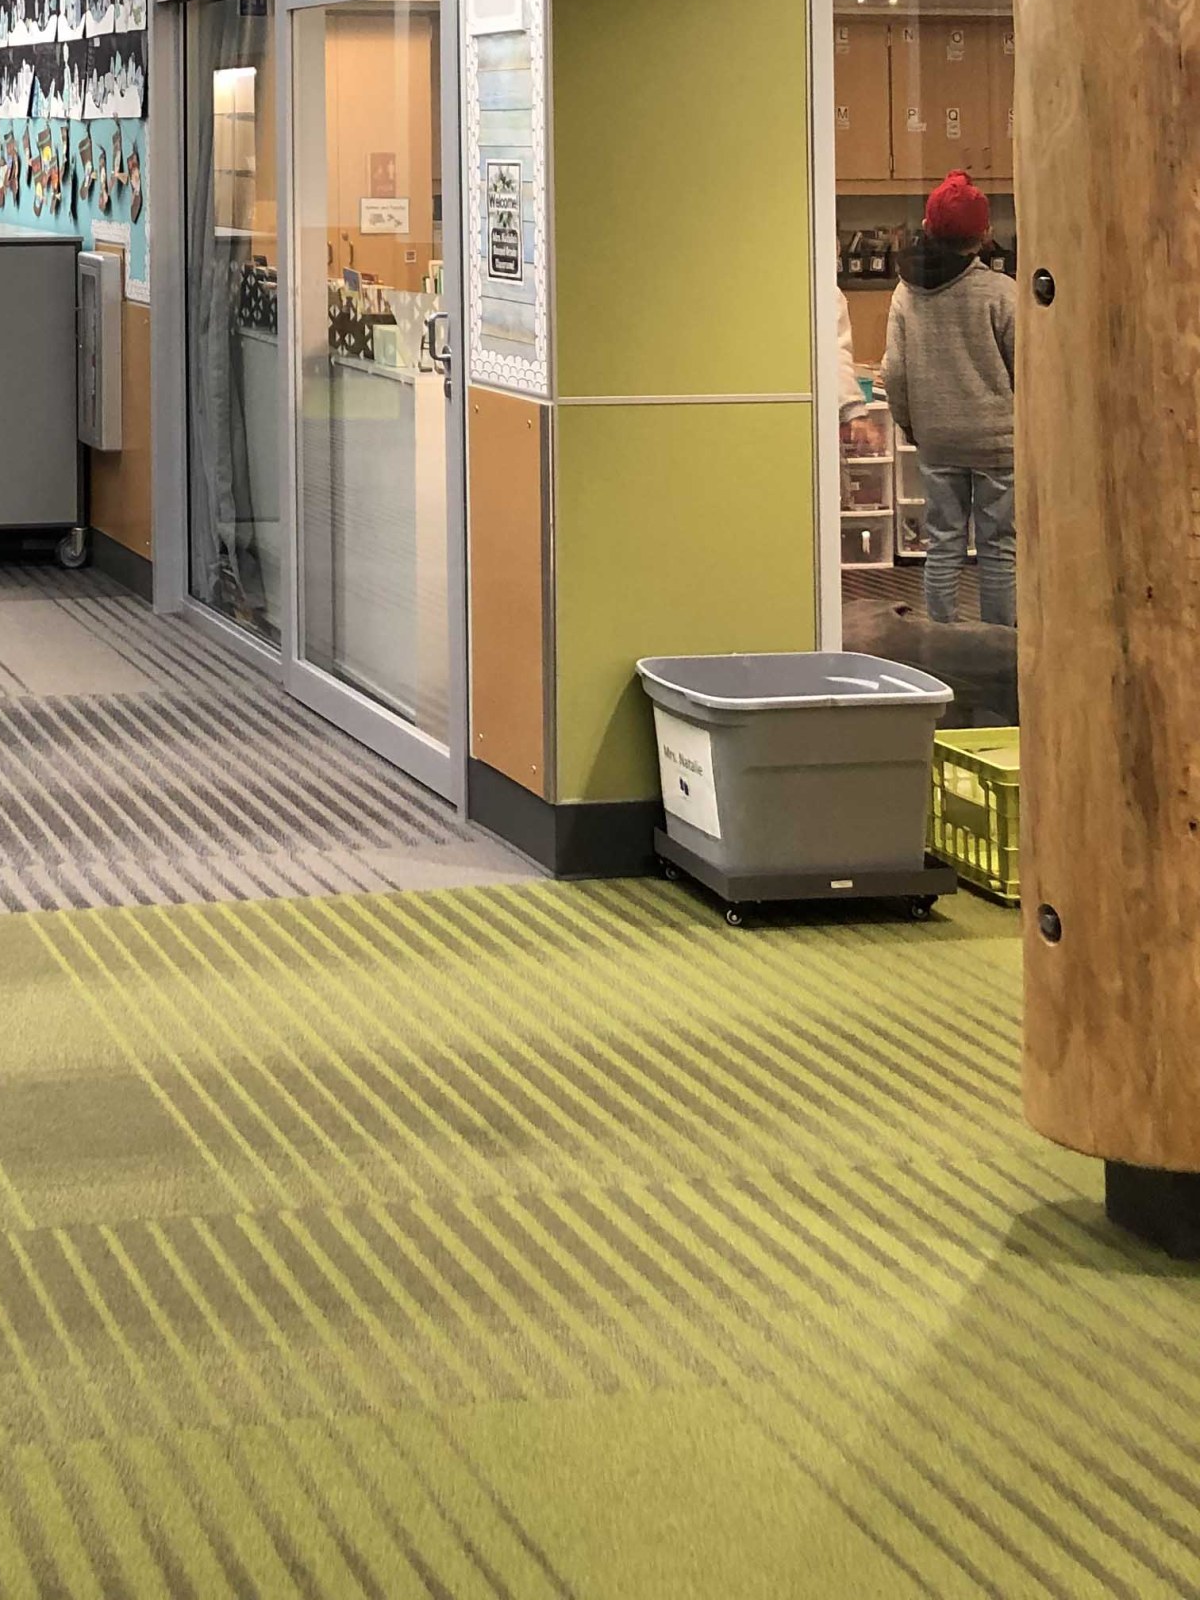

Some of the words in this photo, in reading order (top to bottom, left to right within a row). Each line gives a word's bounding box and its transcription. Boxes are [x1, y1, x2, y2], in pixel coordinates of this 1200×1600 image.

[904, 29, 914, 40] N
[952, 31, 962, 43] O
[837, 107, 848, 119] M
[907, 108, 917, 120] P
[948, 109, 958, 121] Q
[489, 194, 518, 210] Welcome
[663, 743, 678, 763] Mrs.
[678, 752, 704, 777] Natalie
